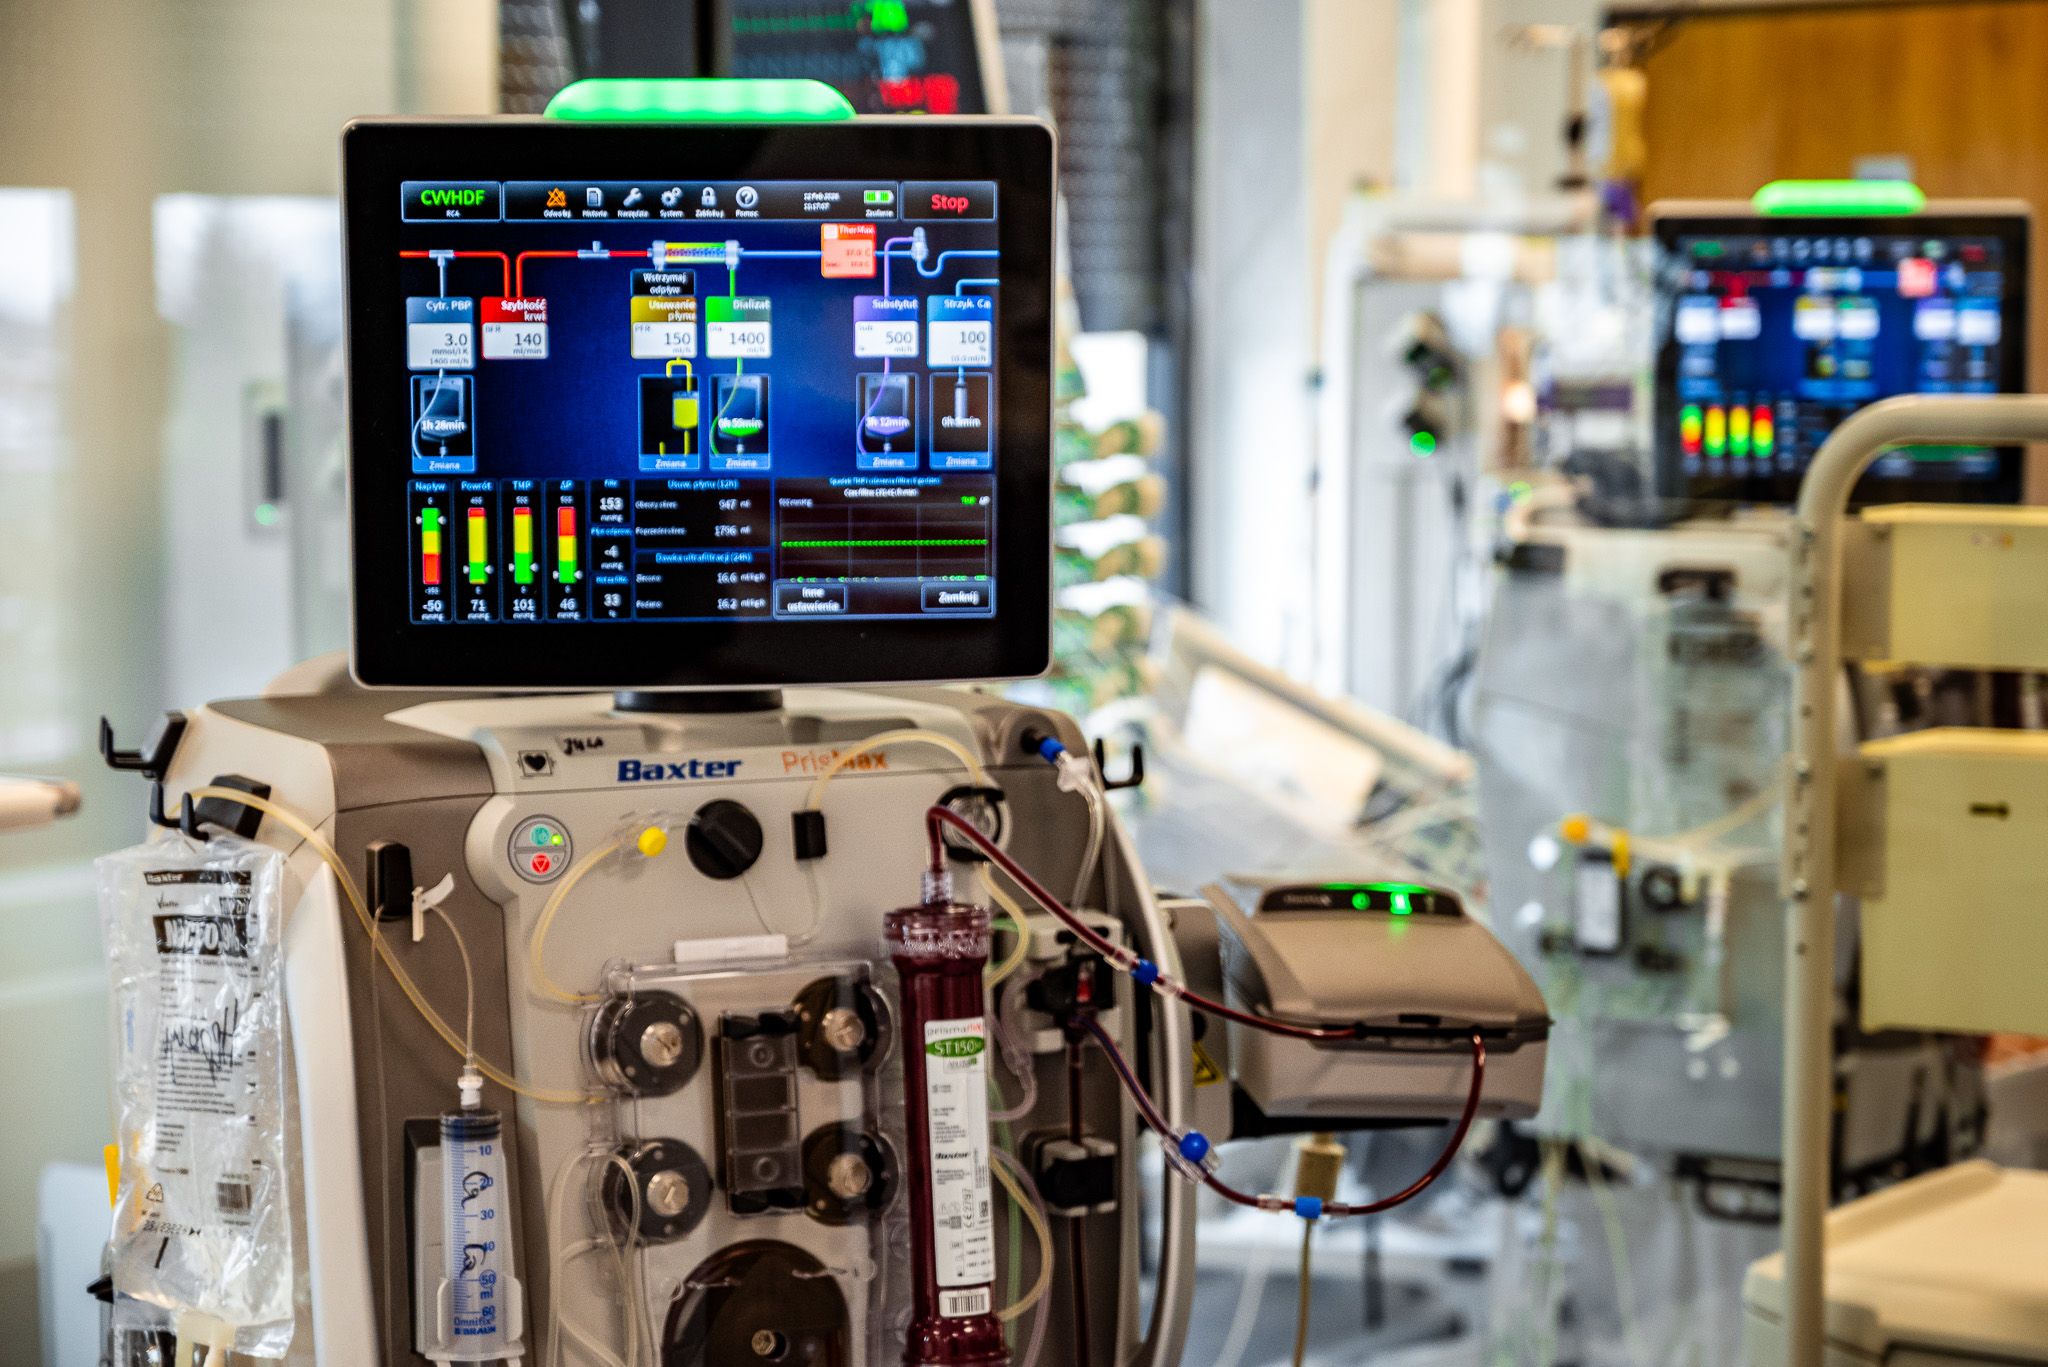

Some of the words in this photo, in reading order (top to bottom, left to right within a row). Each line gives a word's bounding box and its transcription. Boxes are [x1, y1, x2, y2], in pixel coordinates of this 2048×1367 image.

[421, 189, 485, 206] CVVHDF
[931, 194, 969, 212] Stop
[660, 209, 684, 218] System
[735, 209, 759, 218] Pomoc
[643, 273, 687, 284] Wstrzymaj
[426, 300, 449, 312] Cytr.
[451, 300, 471, 310] PBP
[501, 298, 546, 312] Szybkość
[649, 300, 696, 310] Usuwanie
[733, 299, 770, 310] Dializat
[524, 311, 546, 322] krwi
[444, 333, 468, 346] 3.0
[514, 333, 542, 345] 140
[664, 332, 691, 345] 150
[729, 332, 765, 345] 1400
[886, 331, 912, 344] 500
[960, 331, 986, 344] 100
[429, 460, 460, 471] Zmiana
[656, 458, 686, 469] Zmiana
[726, 458, 757, 468] Zmiana
[461, 480, 492, 491] Powrót
[512, 480, 531, 491] TMP
[600, 497, 623, 511] 153
[717, 572, 738, 584] 16.6
[802, 587, 825, 598] Inne
[938, 591, 979, 605] Zamknij
[422, 599, 443, 612] -50
[470, 599, 487, 612] 71
[513, 598, 535, 612] 101
[560, 598, 577, 611] 46
[604, 593, 621, 607] 33
[717, 598, 738, 610] 16.2
[787, 600, 841, 613] ustawienia
[617, 758, 744, 783] Baxter
[480, 1145, 492, 1155] 10
[480, 1177, 493, 1187] 20
[480, 1208, 495, 1220] 30
[481, 1273, 496, 1286] 50
[480, 1287, 493, 1299] ml
[482, 1305, 496, 1317] 60
